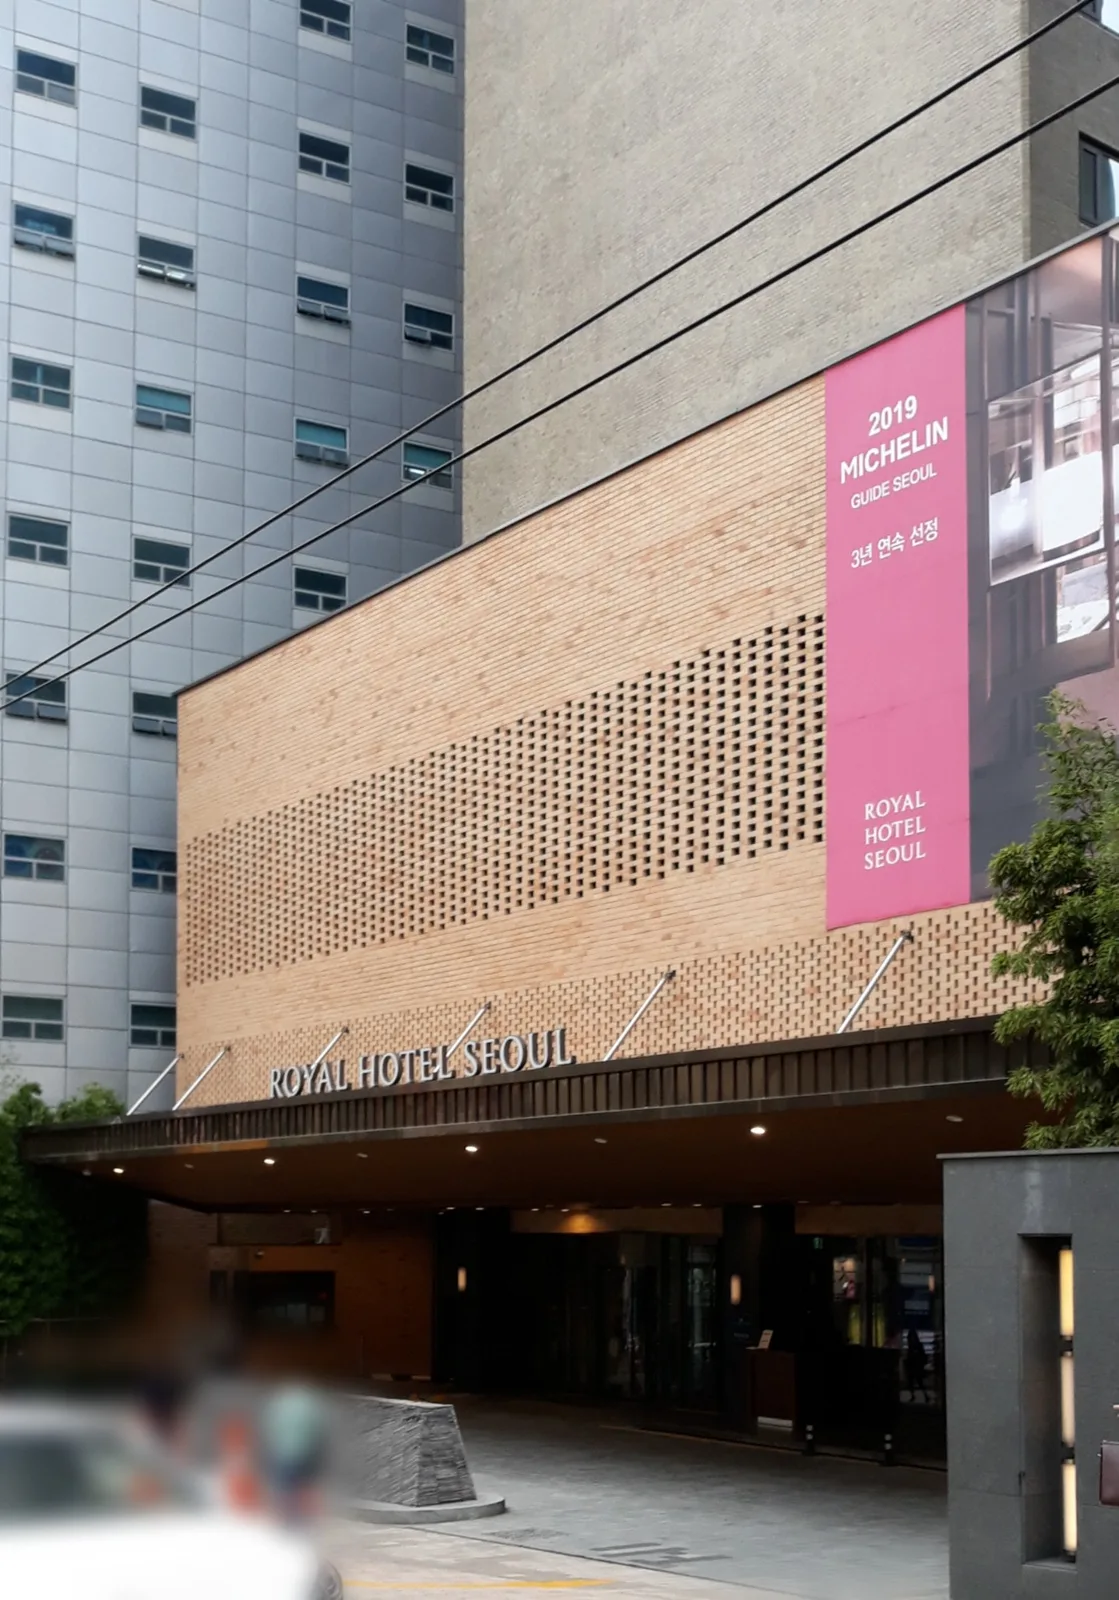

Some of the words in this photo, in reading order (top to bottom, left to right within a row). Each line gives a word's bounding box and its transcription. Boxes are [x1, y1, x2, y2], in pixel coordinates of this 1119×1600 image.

[868, 395, 918, 436] 2019
[840, 416, 949, 484] MICHELIN
[850, 480, 890, 508] GUIDE
[893, 462, 937, 492] SEOUL
[850, 543, 872, 568] 3년
[877, 531, 905, 559] 연속
[910, 517, 938, 546] 선정
[864, 790, 926, 820] ROYAL
[864, 816, 926, 845] HOTEL
[864, 841, 926, 870] SEOUL
[270, 1059, 350, 1099] ROYAL
[358, 1045, 454, 1089] HOTEL
[464, 1028, 575, 1078] SEOUL
